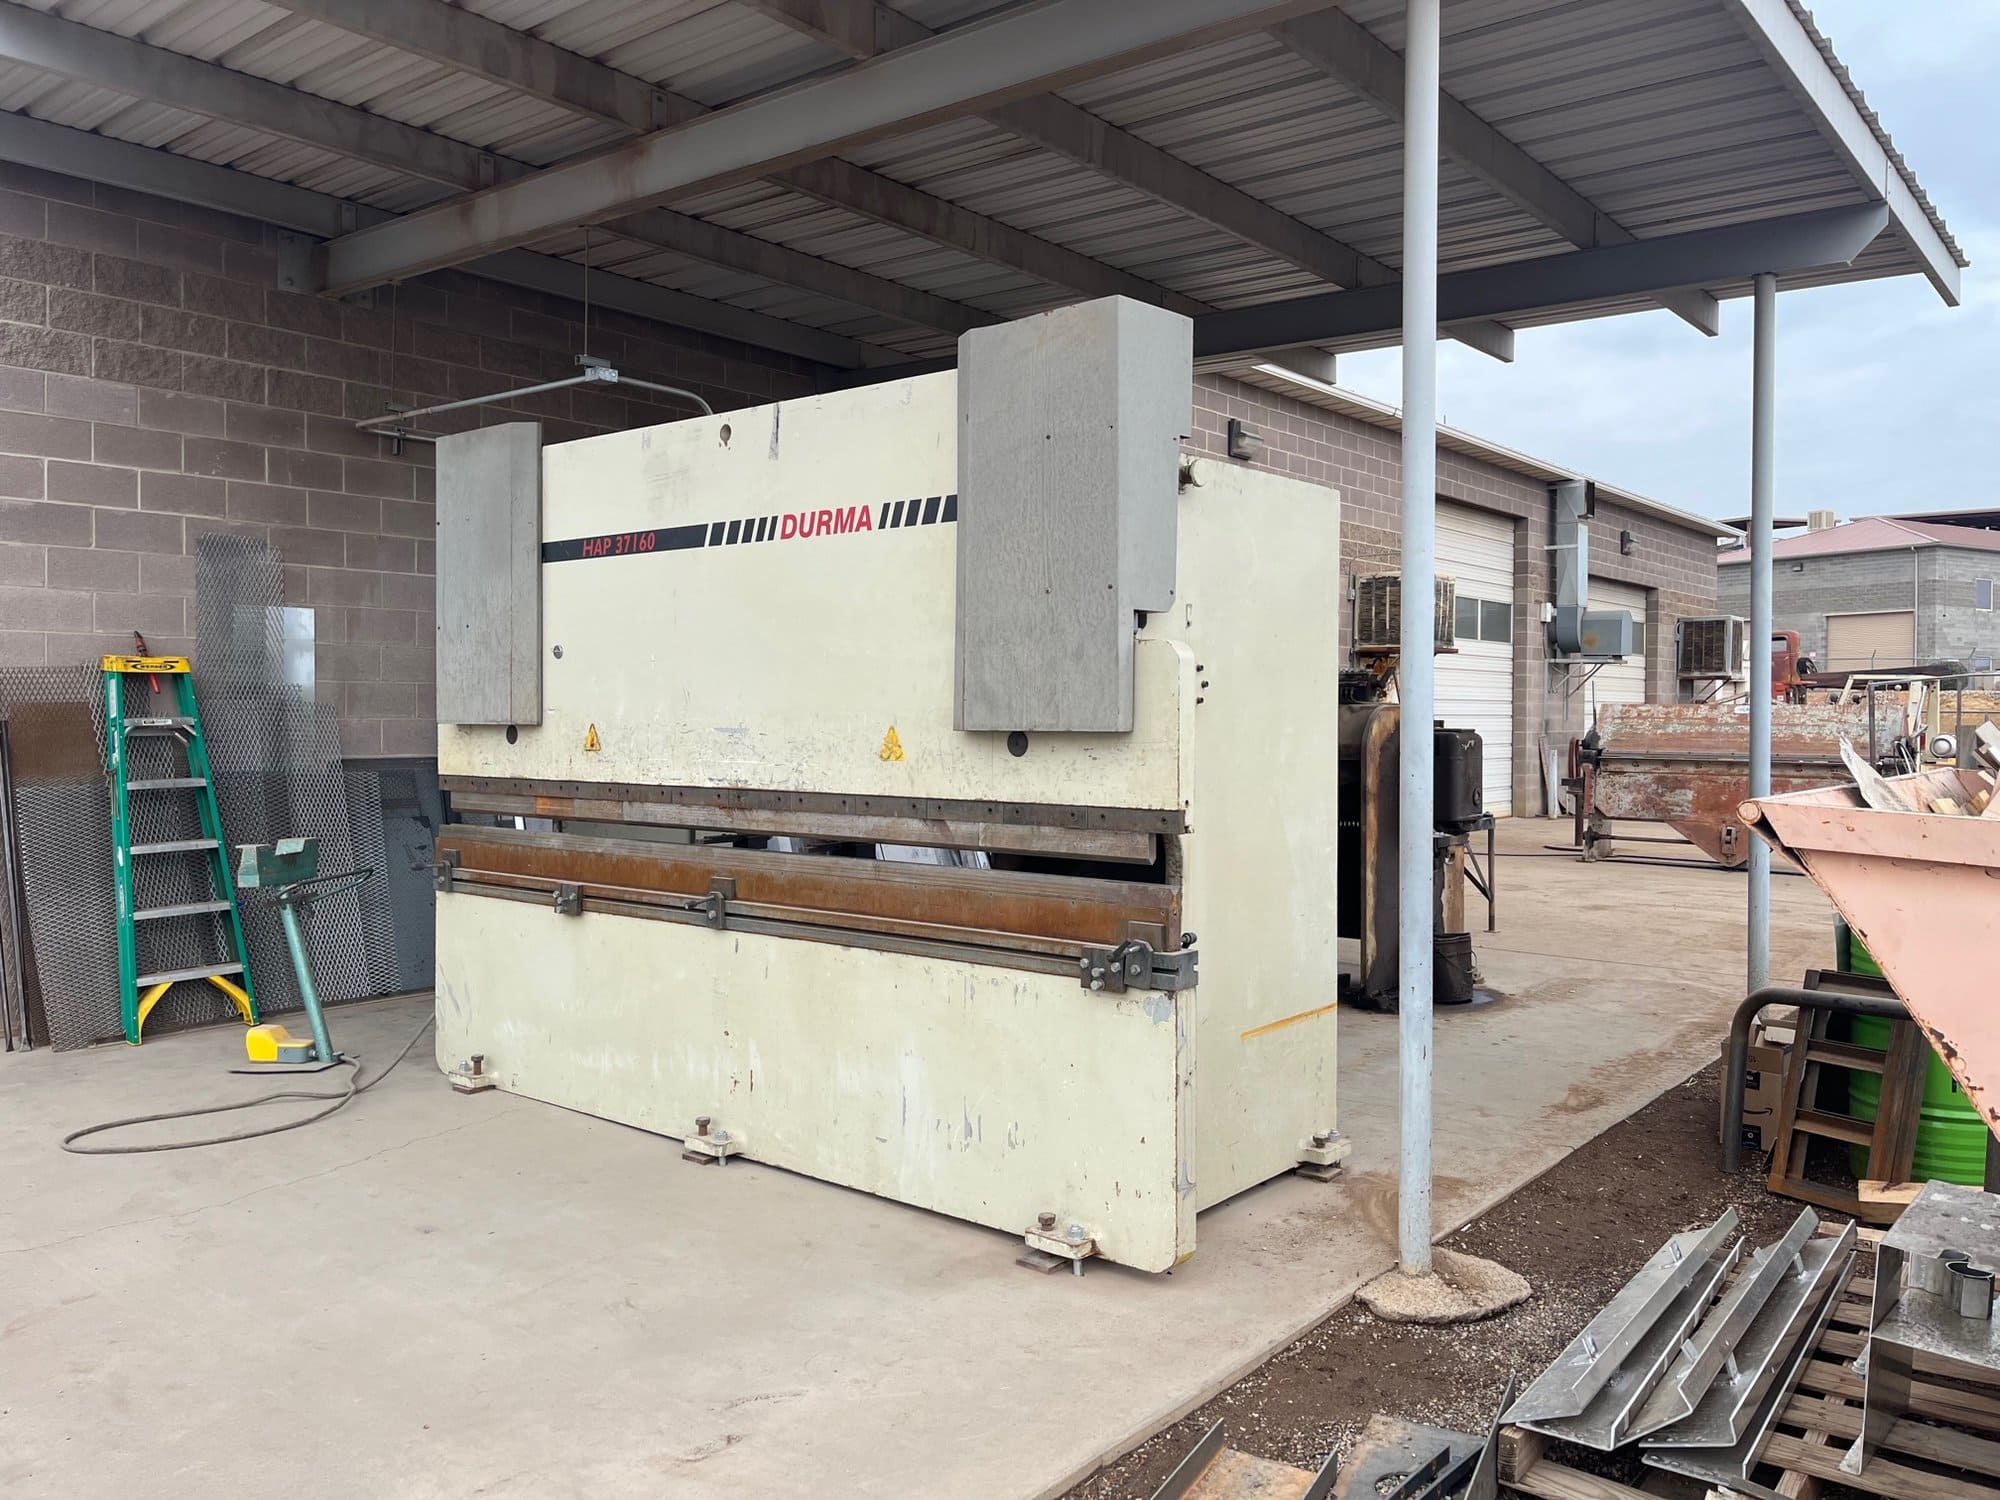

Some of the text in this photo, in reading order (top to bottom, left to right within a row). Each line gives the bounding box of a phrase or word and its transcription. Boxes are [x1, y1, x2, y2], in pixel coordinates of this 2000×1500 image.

[780, 505, 872, 540] DURMA
[582, 532, 655, 557] HAP 37160
